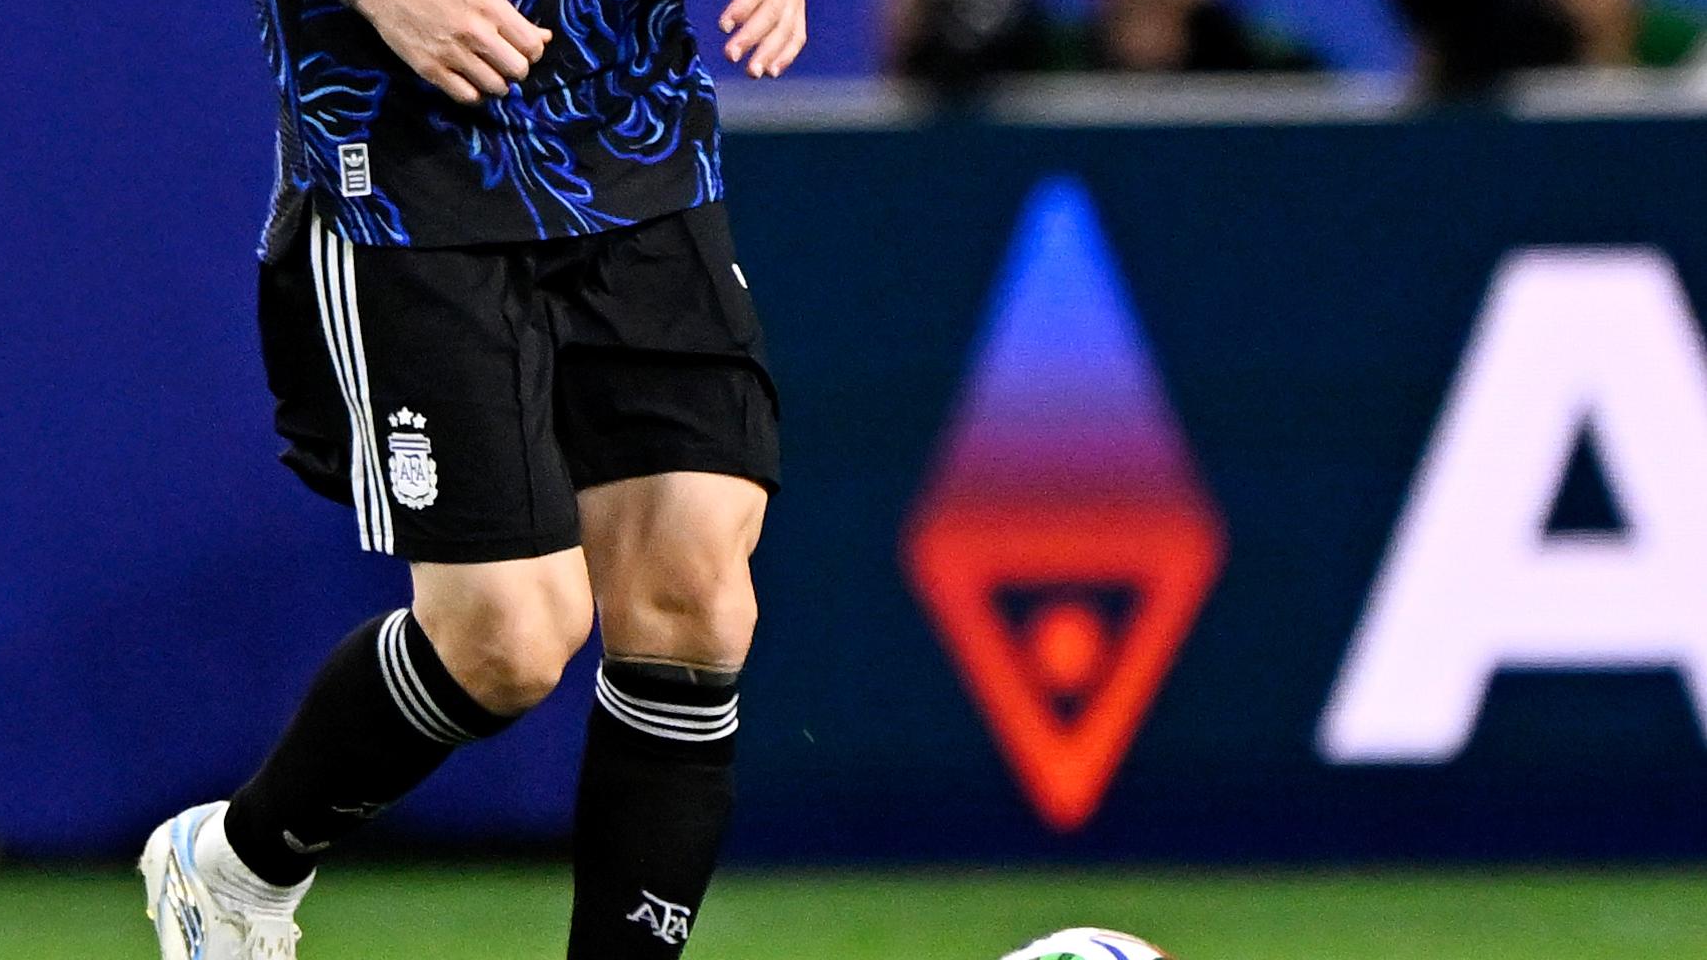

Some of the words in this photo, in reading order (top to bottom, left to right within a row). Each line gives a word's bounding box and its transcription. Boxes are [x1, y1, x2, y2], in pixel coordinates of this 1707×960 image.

[400, 453, 426, 487] AFA
[1313, 246, 1707, 764] A
[626, 889, 691, 944] AFA
